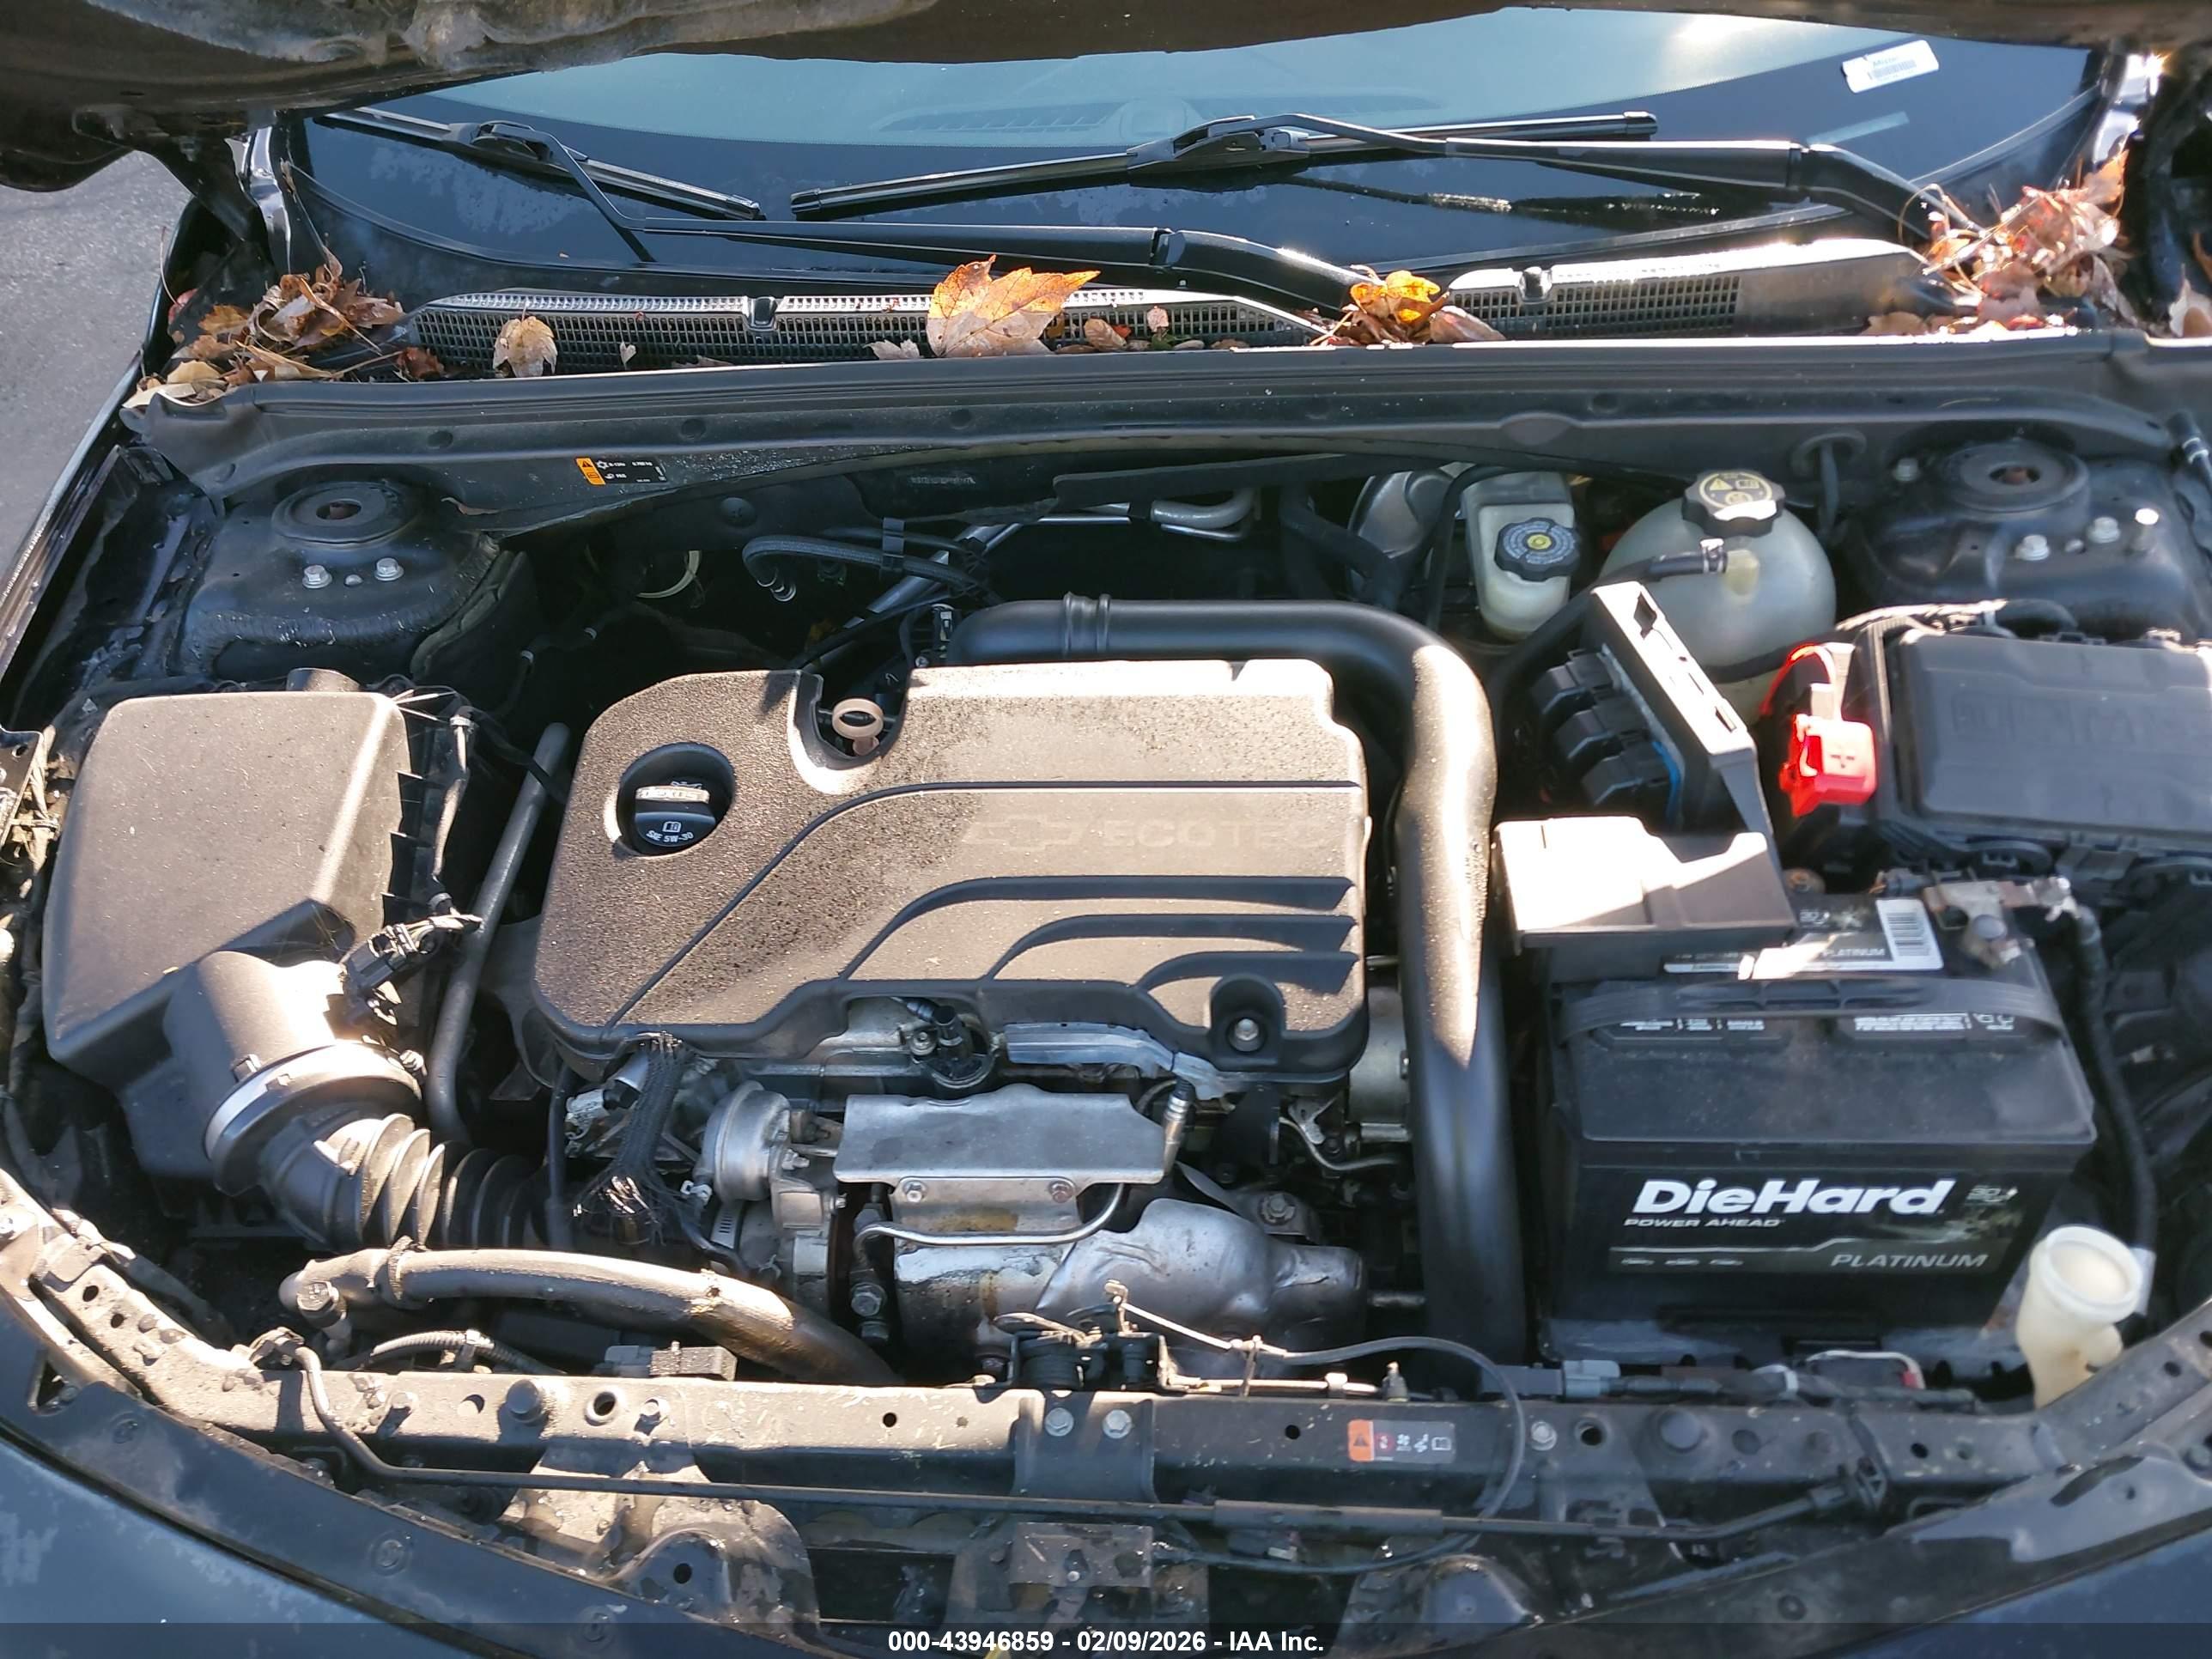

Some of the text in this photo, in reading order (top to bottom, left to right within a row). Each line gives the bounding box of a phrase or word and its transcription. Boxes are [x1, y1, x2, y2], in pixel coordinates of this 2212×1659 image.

[646, 830, 662, 841] SAE
[1103, 818, 1330, 848] ECOTEC
[1632, 1177, 1956, 1214] DieHard
[1624, 1218, 1783, 1228] POWER AHEAD
[1831, 1253, 1989, 1267] PLATINUM
